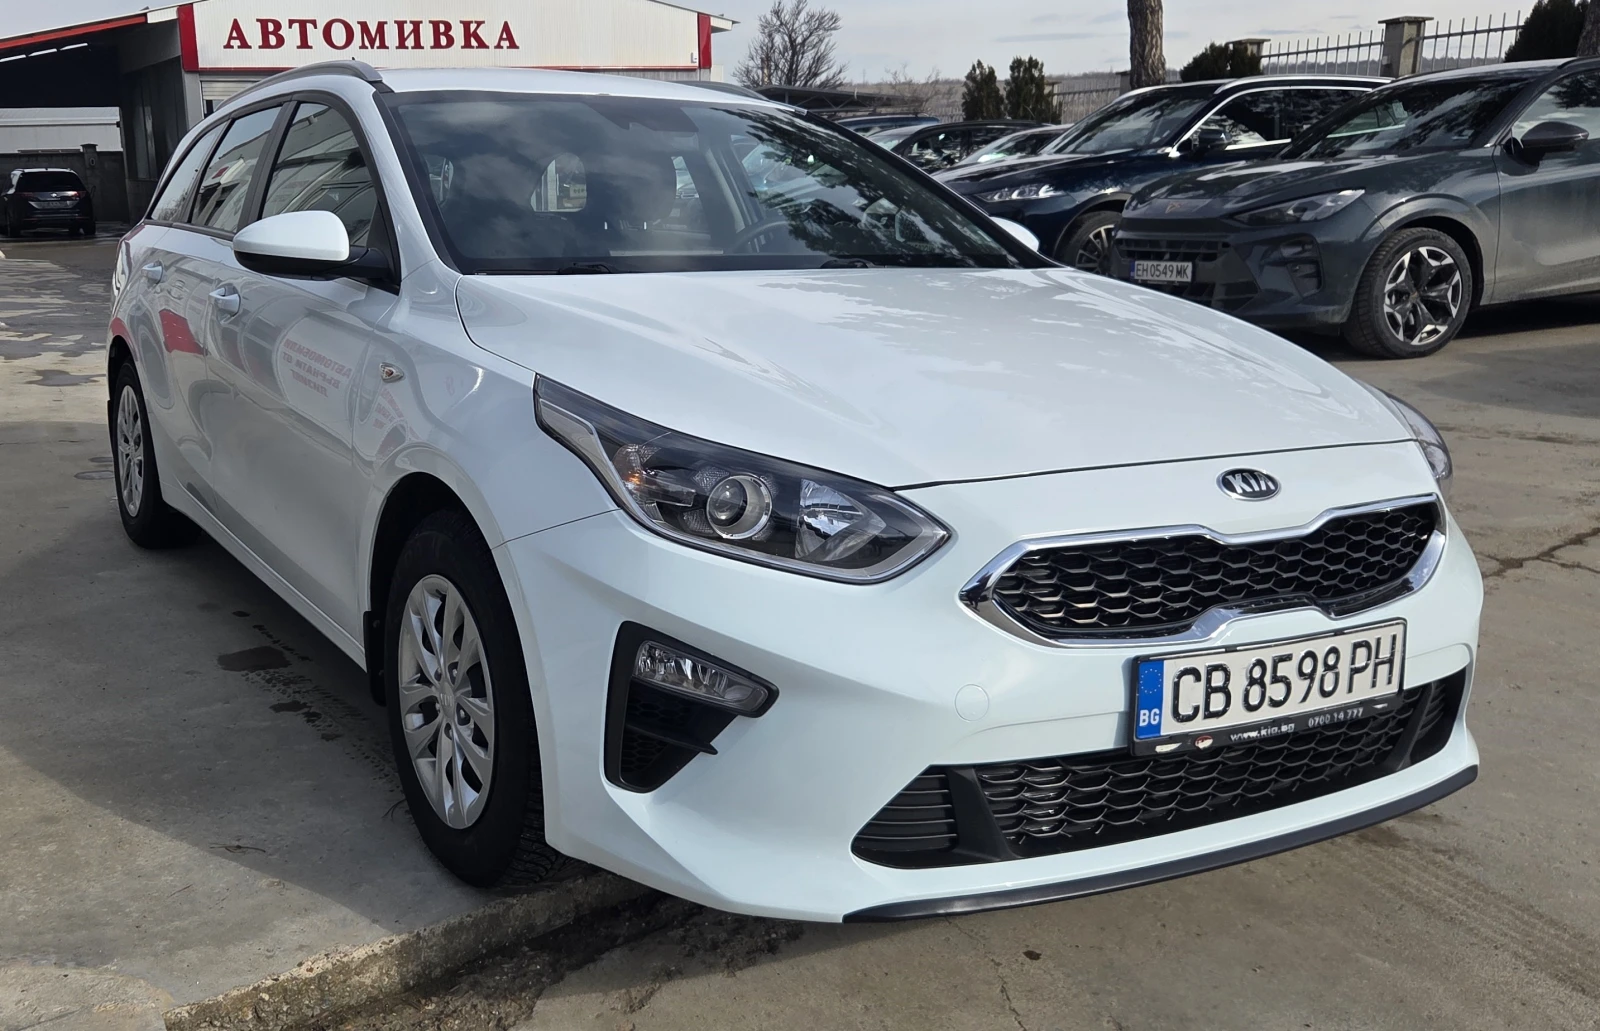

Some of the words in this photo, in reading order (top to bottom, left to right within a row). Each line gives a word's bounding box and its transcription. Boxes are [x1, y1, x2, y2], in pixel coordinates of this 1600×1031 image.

[223, 18, 520, 50] АВТОМИВКА
[1149, 263, 1174, 278] 0549
[1225, 471, 1276, 494] KIA
[1171, 662, 1232, 723] CB
[1242, 645, 1341, 713] 8598
[1346, 633, 1398, 694] PH
[1138, 708, 1160, 727] BG
[1308, 713, 1331, 728] 0700
[1333, 711, 1345, 722] 14
[1346, 707, 1364, 718] 777
